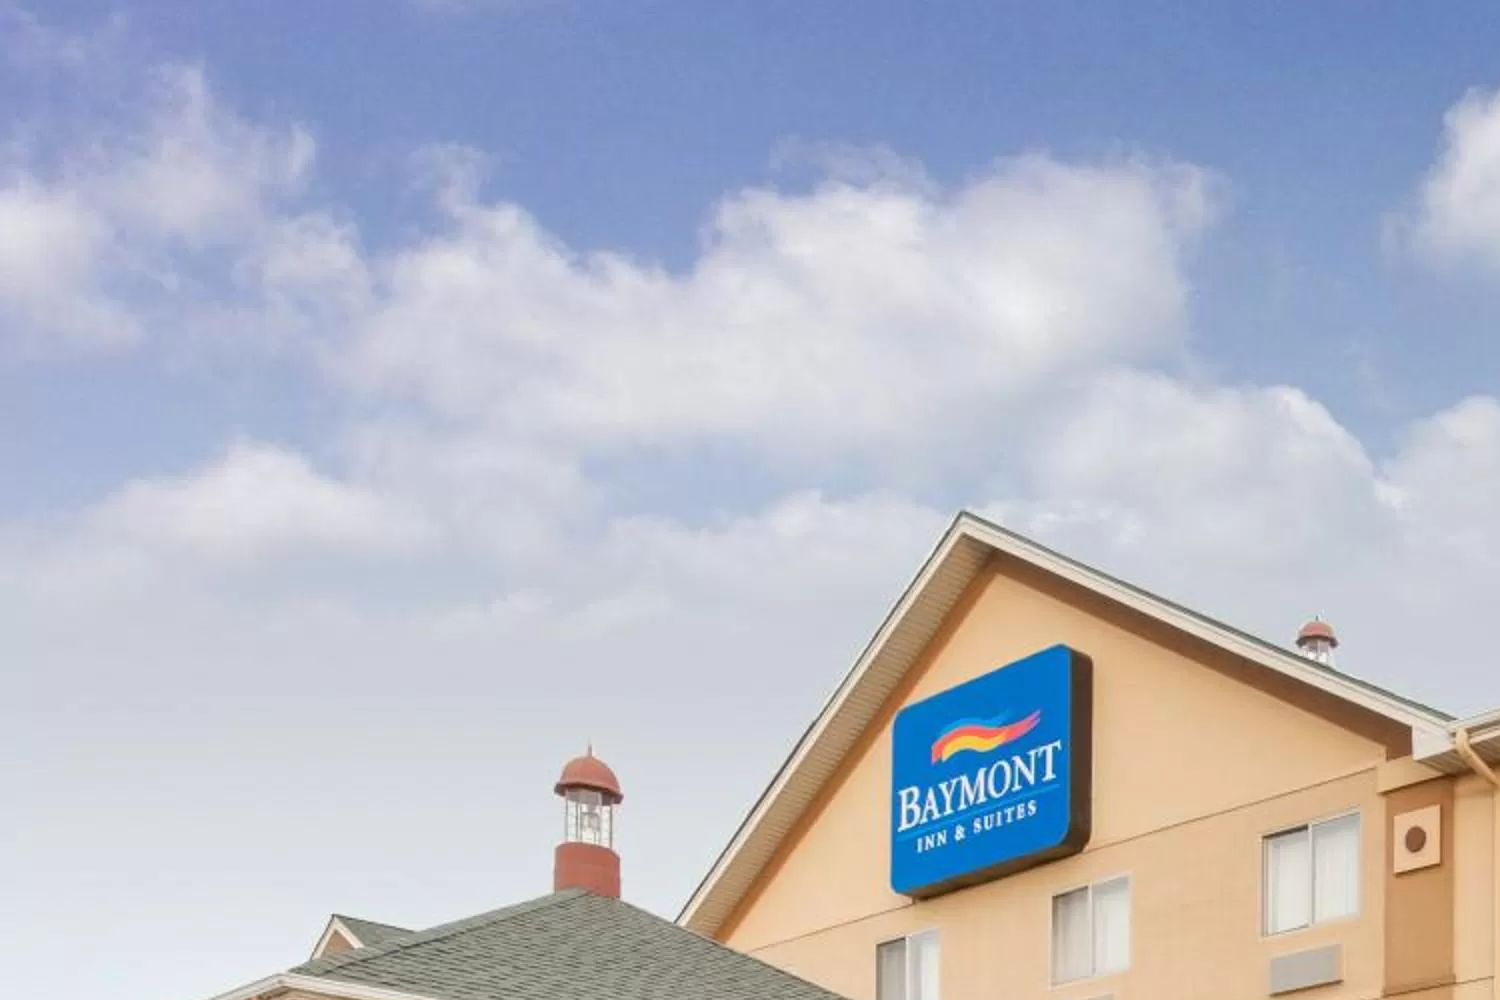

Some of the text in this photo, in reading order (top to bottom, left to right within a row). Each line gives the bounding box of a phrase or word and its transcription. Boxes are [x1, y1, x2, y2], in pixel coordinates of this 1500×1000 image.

[897, 740, 1062, 832] BAYMONT
[917, 799, 1037, 853] INN & SUITES
